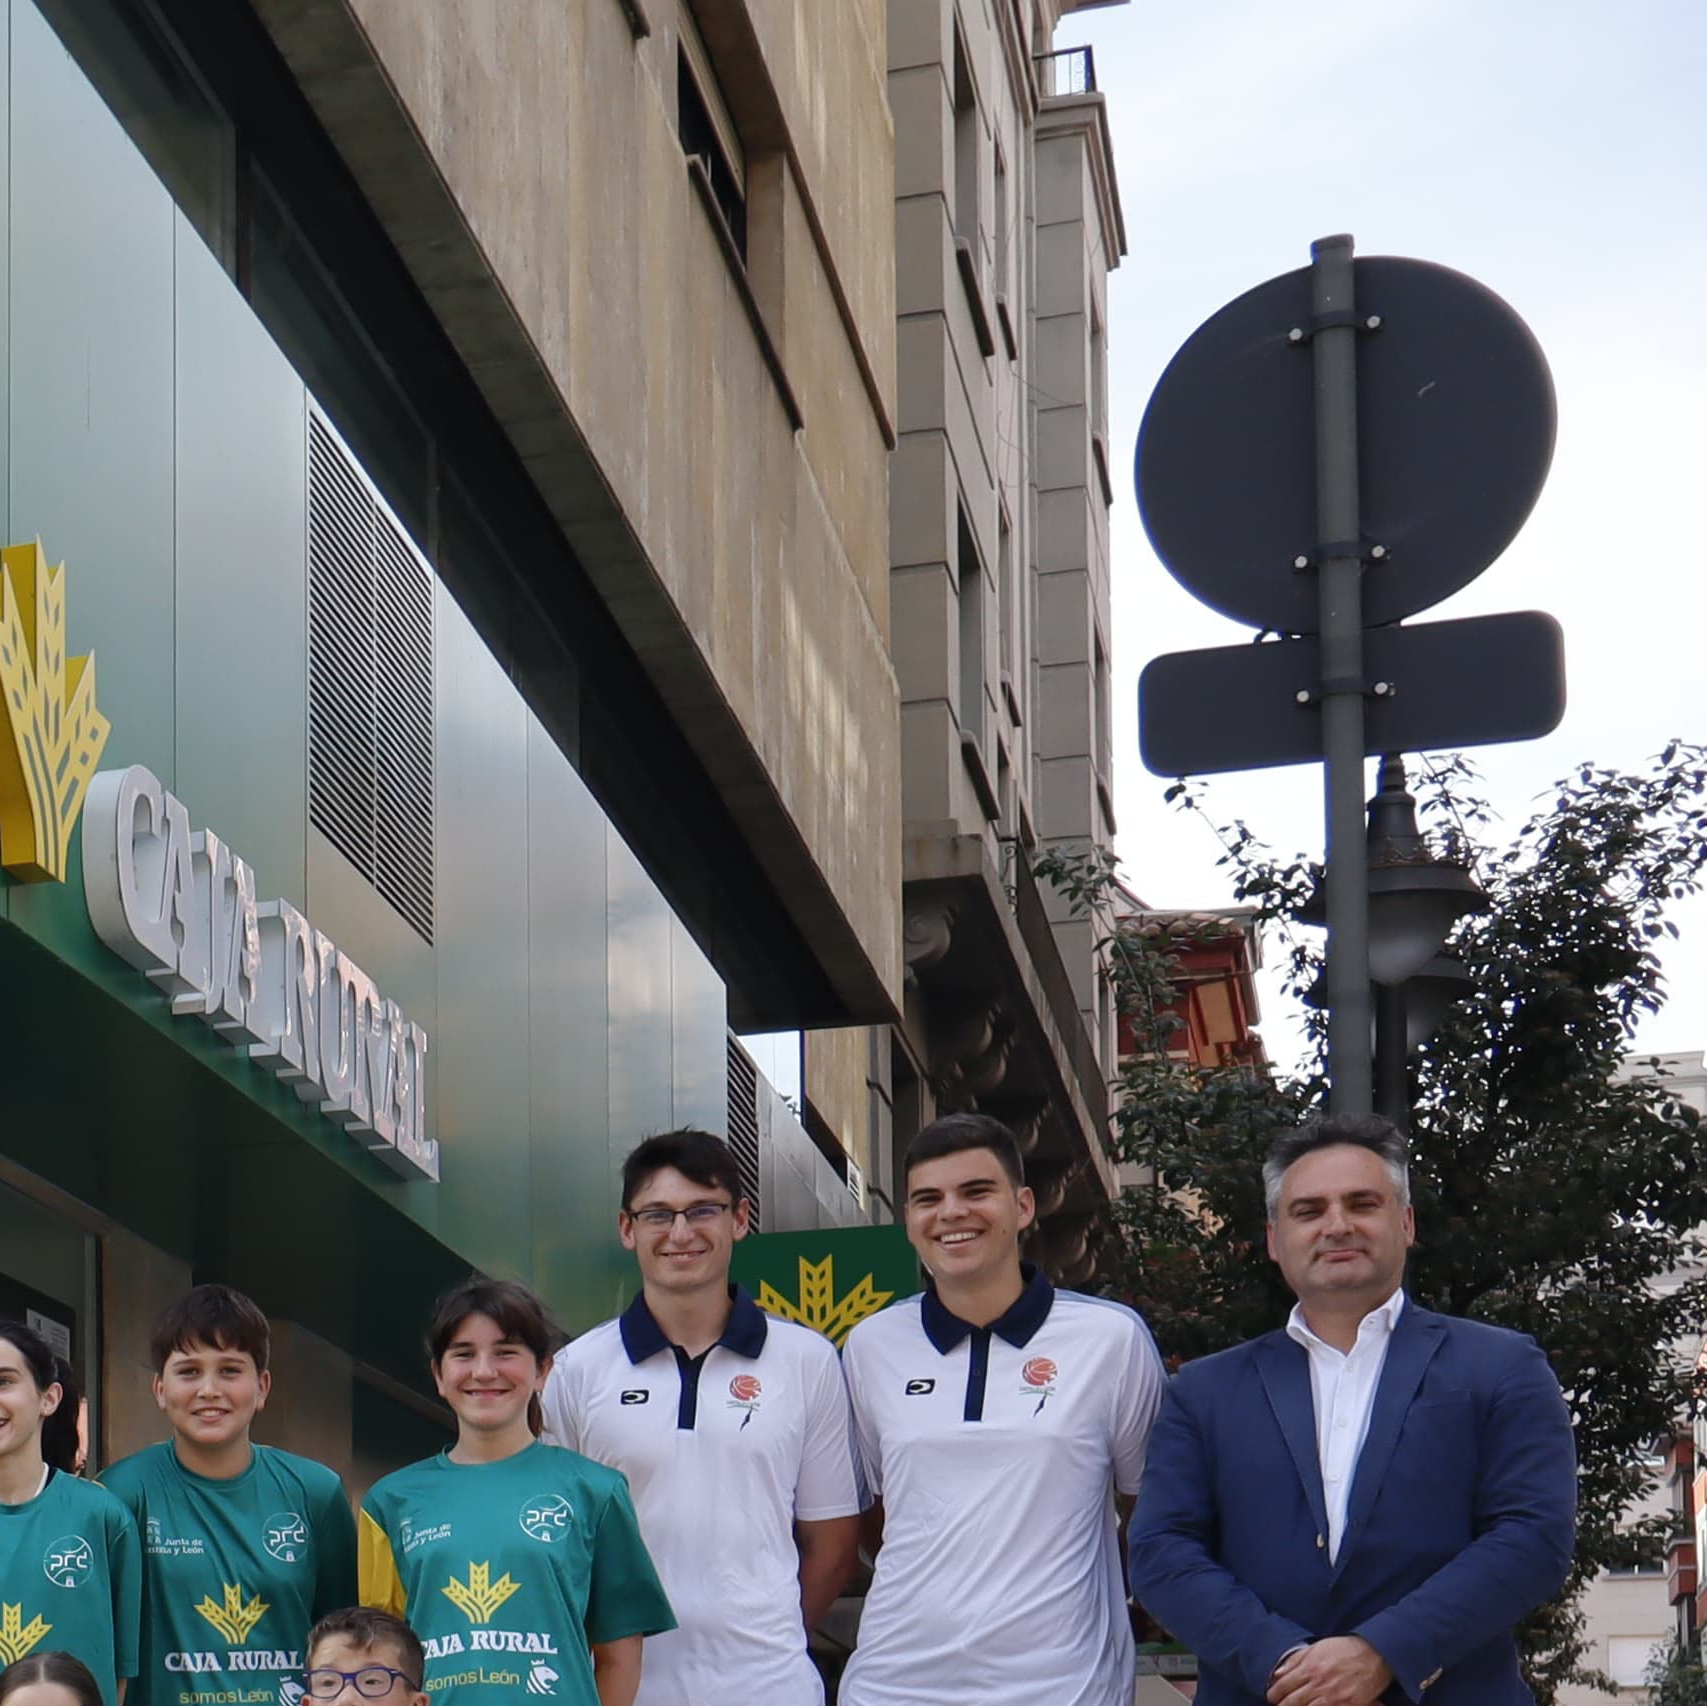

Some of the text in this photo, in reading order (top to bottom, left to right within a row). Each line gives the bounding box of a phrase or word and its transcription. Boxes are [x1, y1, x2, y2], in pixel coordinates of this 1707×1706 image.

[470, 1631, 558, 1655] RURAL
[165, 1650, 303, 1674] CAJA RURAL
